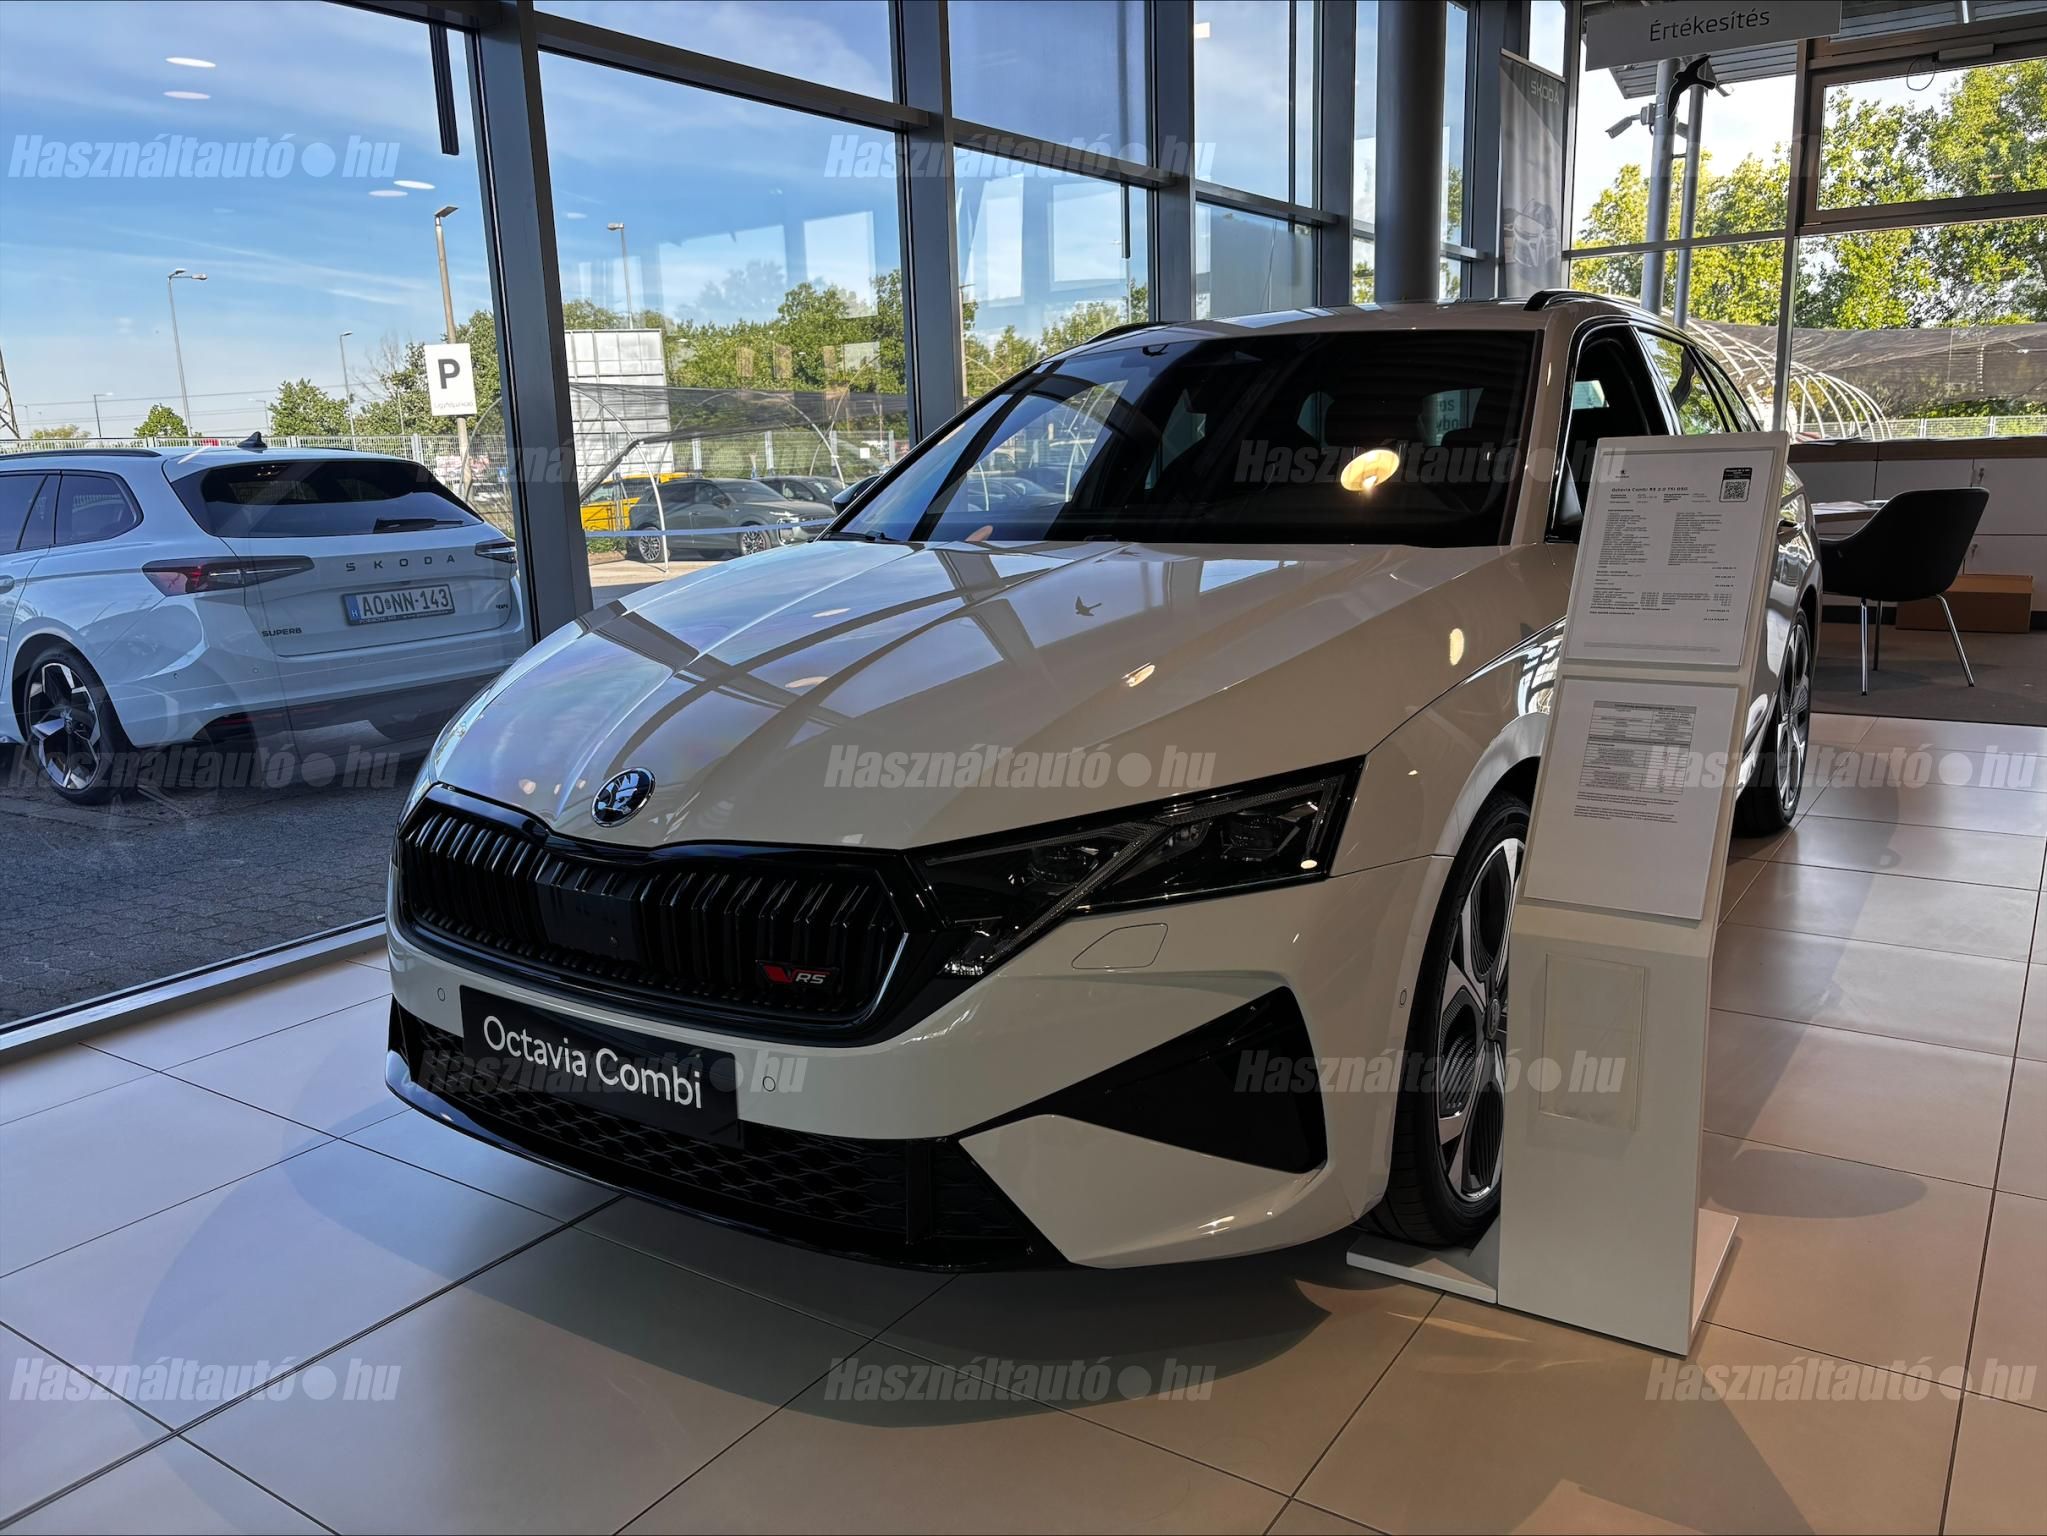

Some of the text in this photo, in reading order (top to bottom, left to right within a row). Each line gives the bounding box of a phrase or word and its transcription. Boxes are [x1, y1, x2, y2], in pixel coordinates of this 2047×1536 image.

[1649, 8, 1771, 42] Értékesítés
[437, 358, 461, 389] P
[261, 627, 303, 638] SUPERB
[483, 1015, 702, 1109] Octavia Combi
